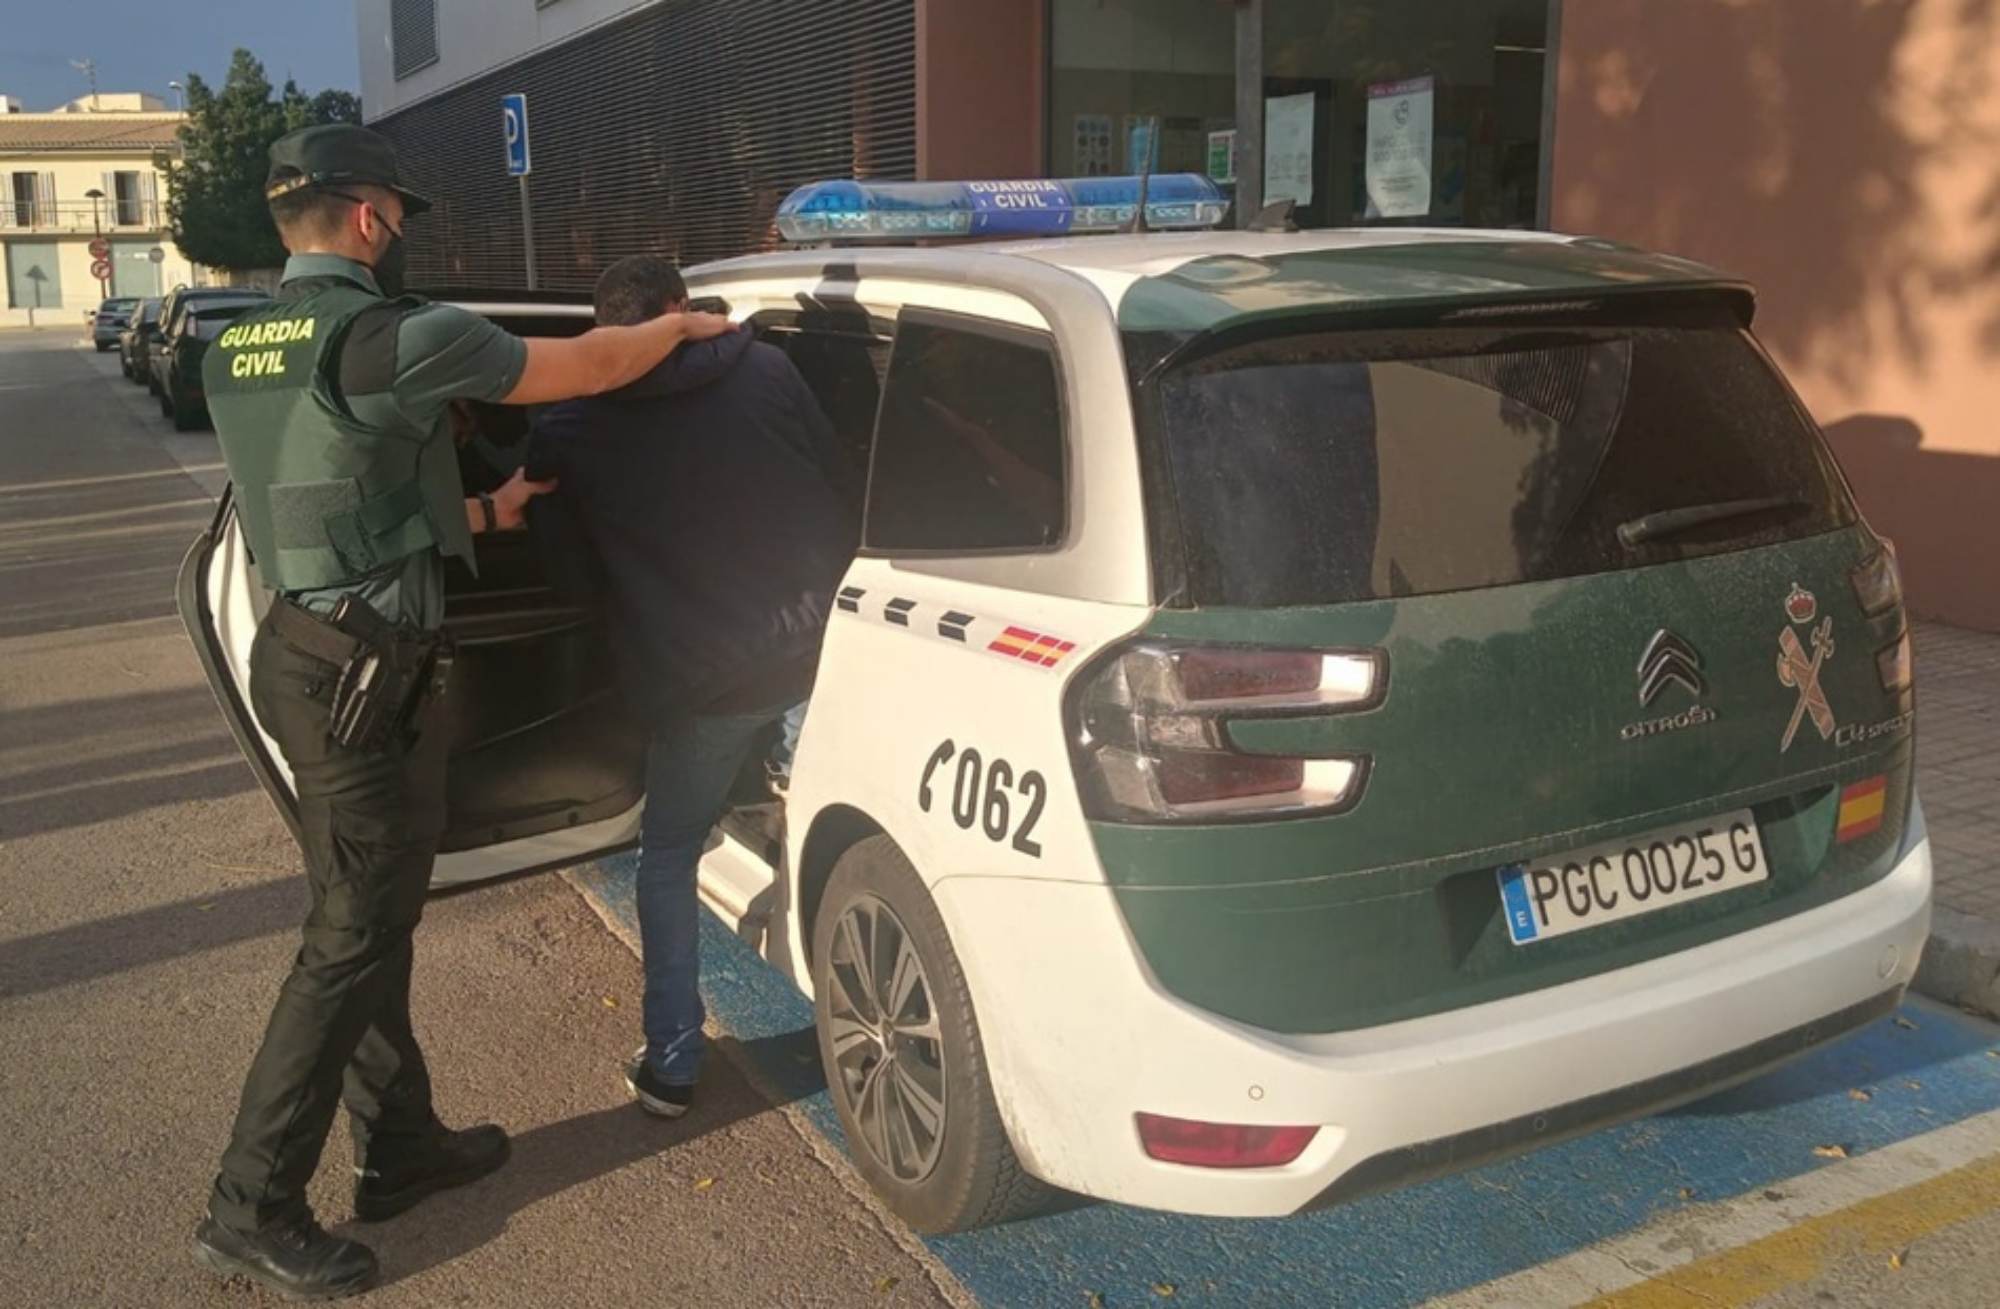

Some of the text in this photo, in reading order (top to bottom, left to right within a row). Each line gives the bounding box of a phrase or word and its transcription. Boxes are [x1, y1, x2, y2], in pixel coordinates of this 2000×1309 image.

[503, 108, 519, 169] P
[969, 181, 1057, 193] GUARDIA
[995, 193, 1047, 208] CIVIL
[220, 317, 315, 348] GUARDIA
[231, 350, 285, 378] CIVIL
[952, 747, 1047, 859] 062
[1531, 822, 1757, 926] PGC 0025 G
[1516, 910, 1528, 927] E
